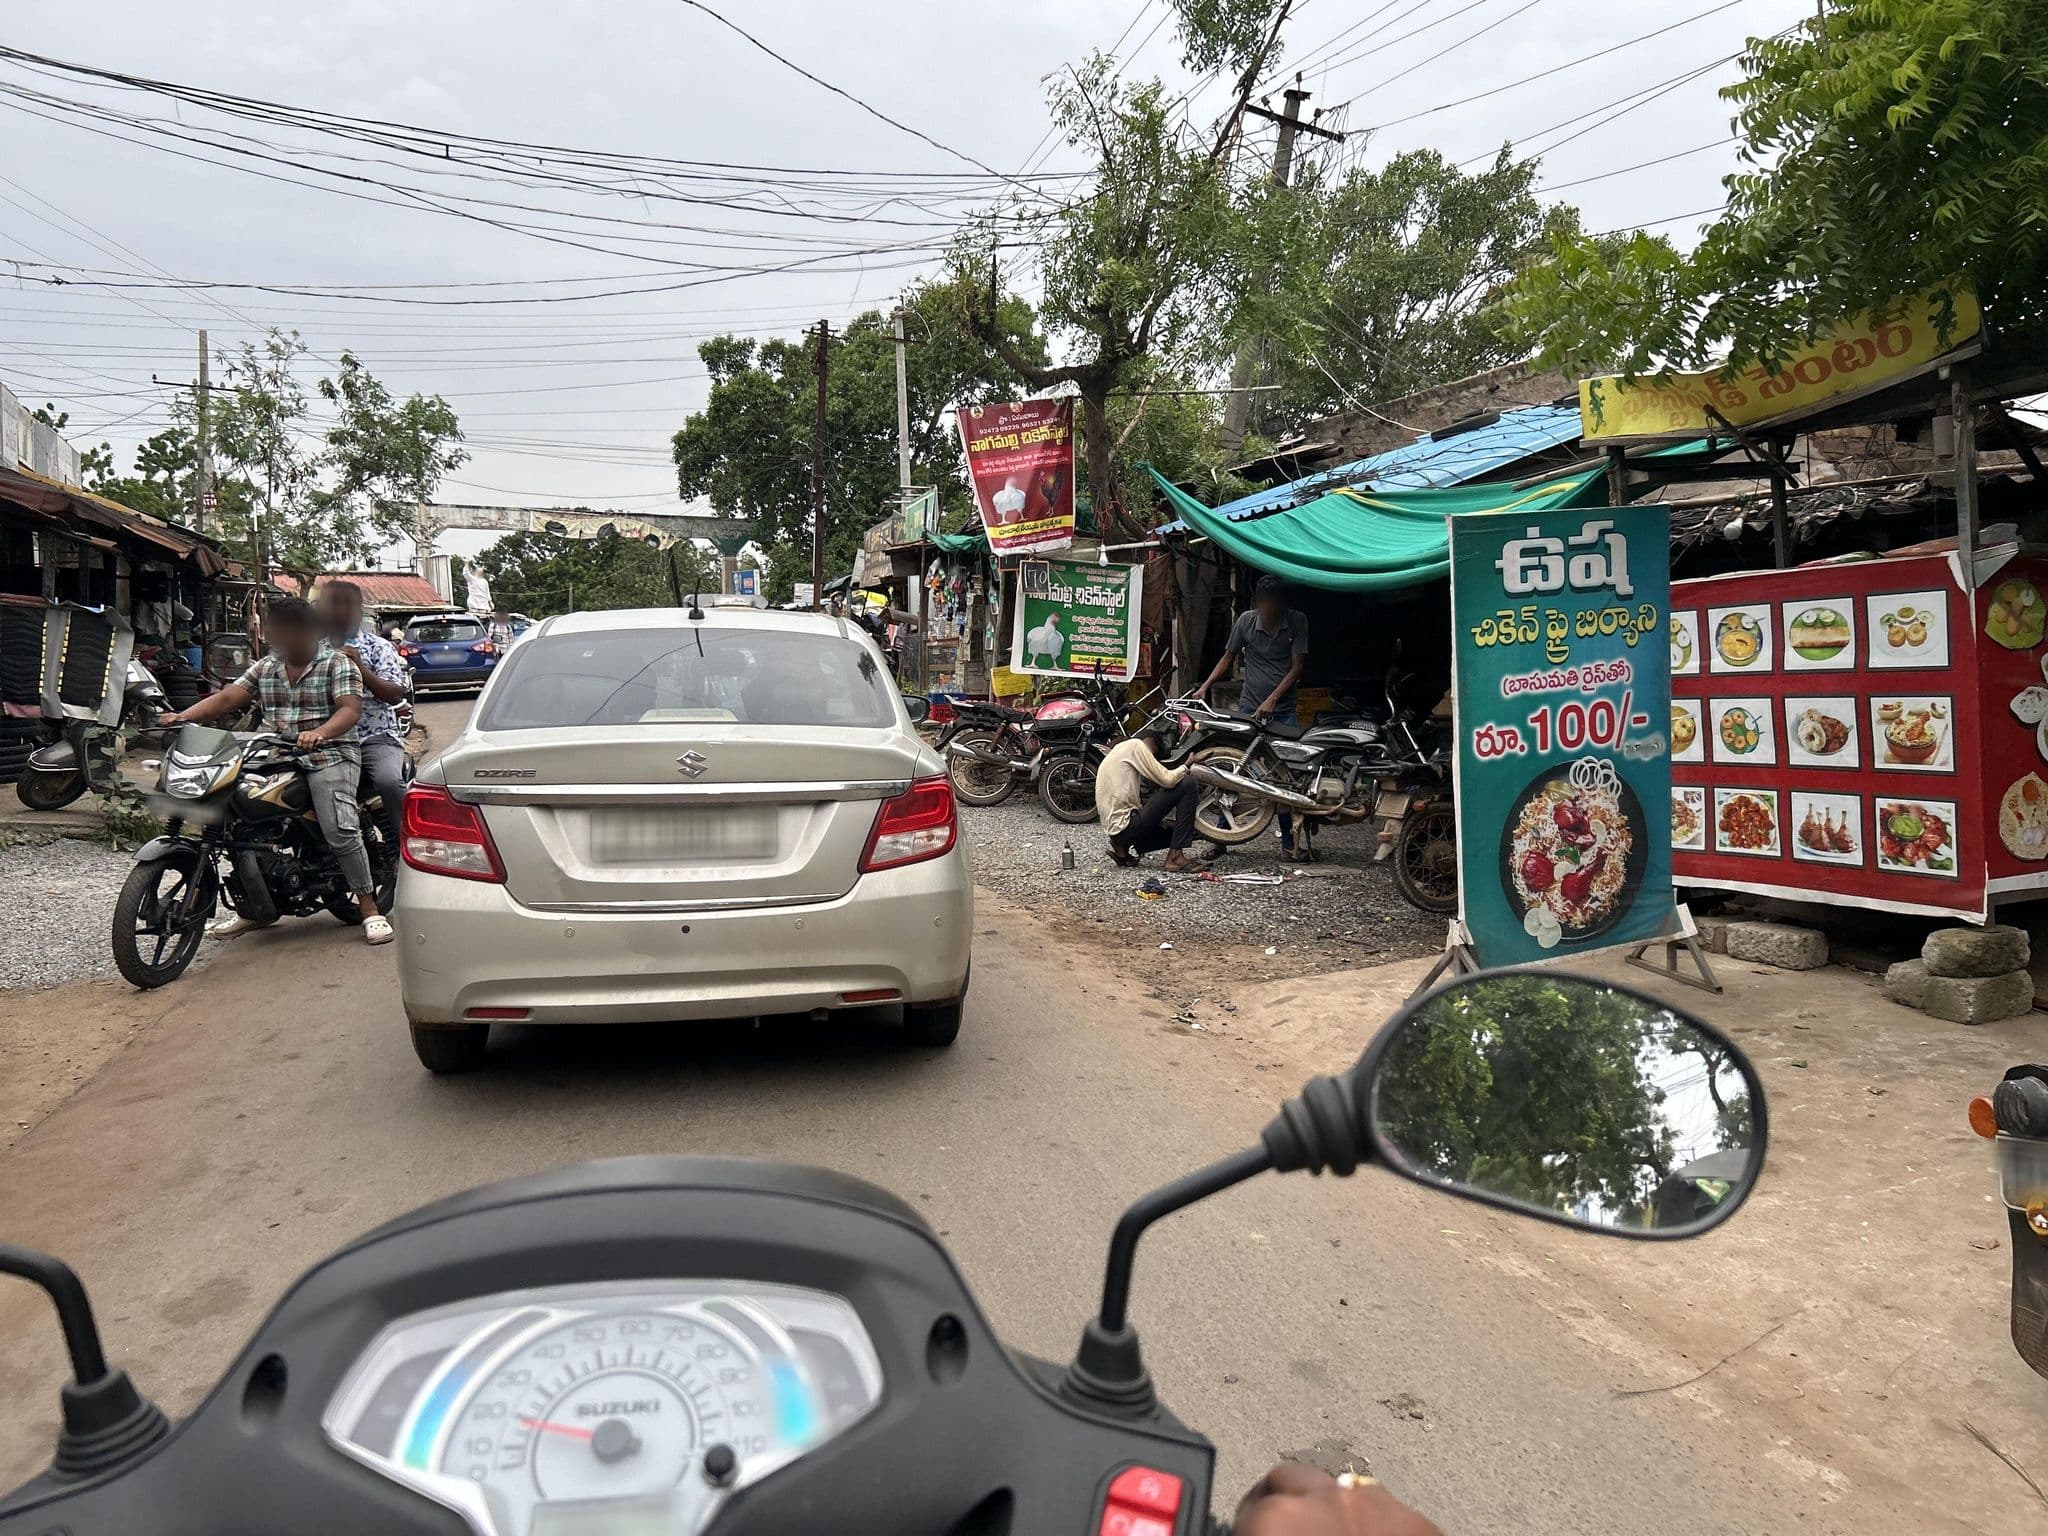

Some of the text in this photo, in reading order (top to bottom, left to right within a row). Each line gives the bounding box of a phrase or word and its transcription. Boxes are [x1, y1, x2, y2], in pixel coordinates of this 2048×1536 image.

[970, 433, 1020, 452] నాగమల్లి
[1495, 520, 1634, 595] ఉష
[1471, 605, 1540, 648] చికెన్
[1575, 603, 1658, 647] బిర్యాని
[474, 768, 537, 778] DZIRE
[664, 1325, 694, 1341] 70
[576, 1400, 661, 1418] SUZUKI
